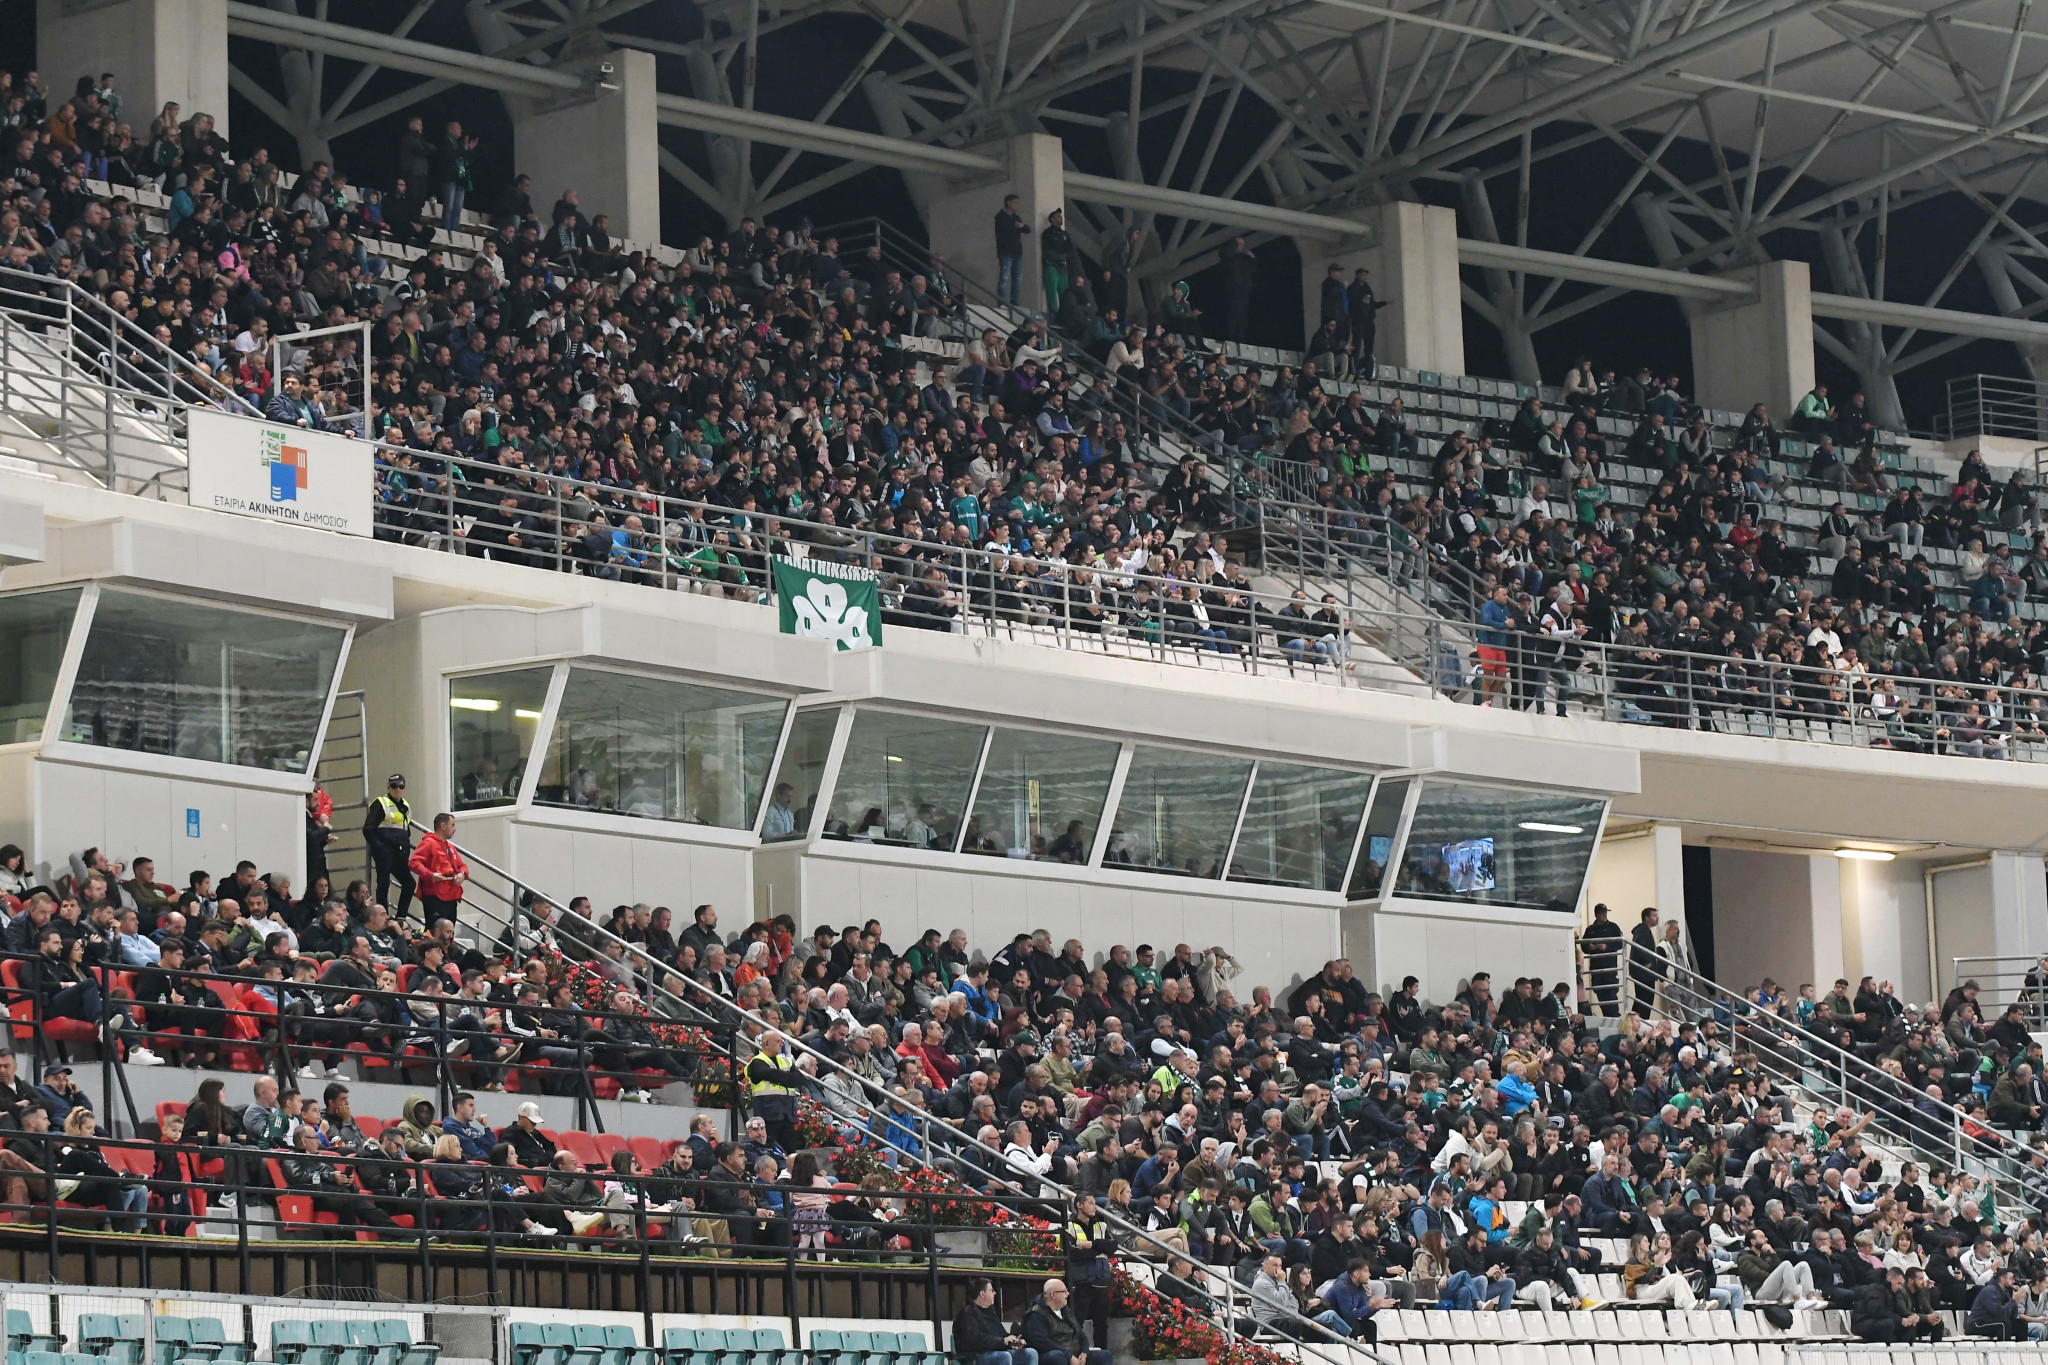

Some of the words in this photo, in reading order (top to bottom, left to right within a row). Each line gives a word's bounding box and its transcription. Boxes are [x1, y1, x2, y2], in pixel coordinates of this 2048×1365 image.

[214, 495, 246, 510] ΕΤΑΙΡΙΑ
[248, 501, 299, 520] ΑΚΙΝΗΤΩΝ
[303, 511, 349, 528] ΔΗΜΟΣΙΟΥ
